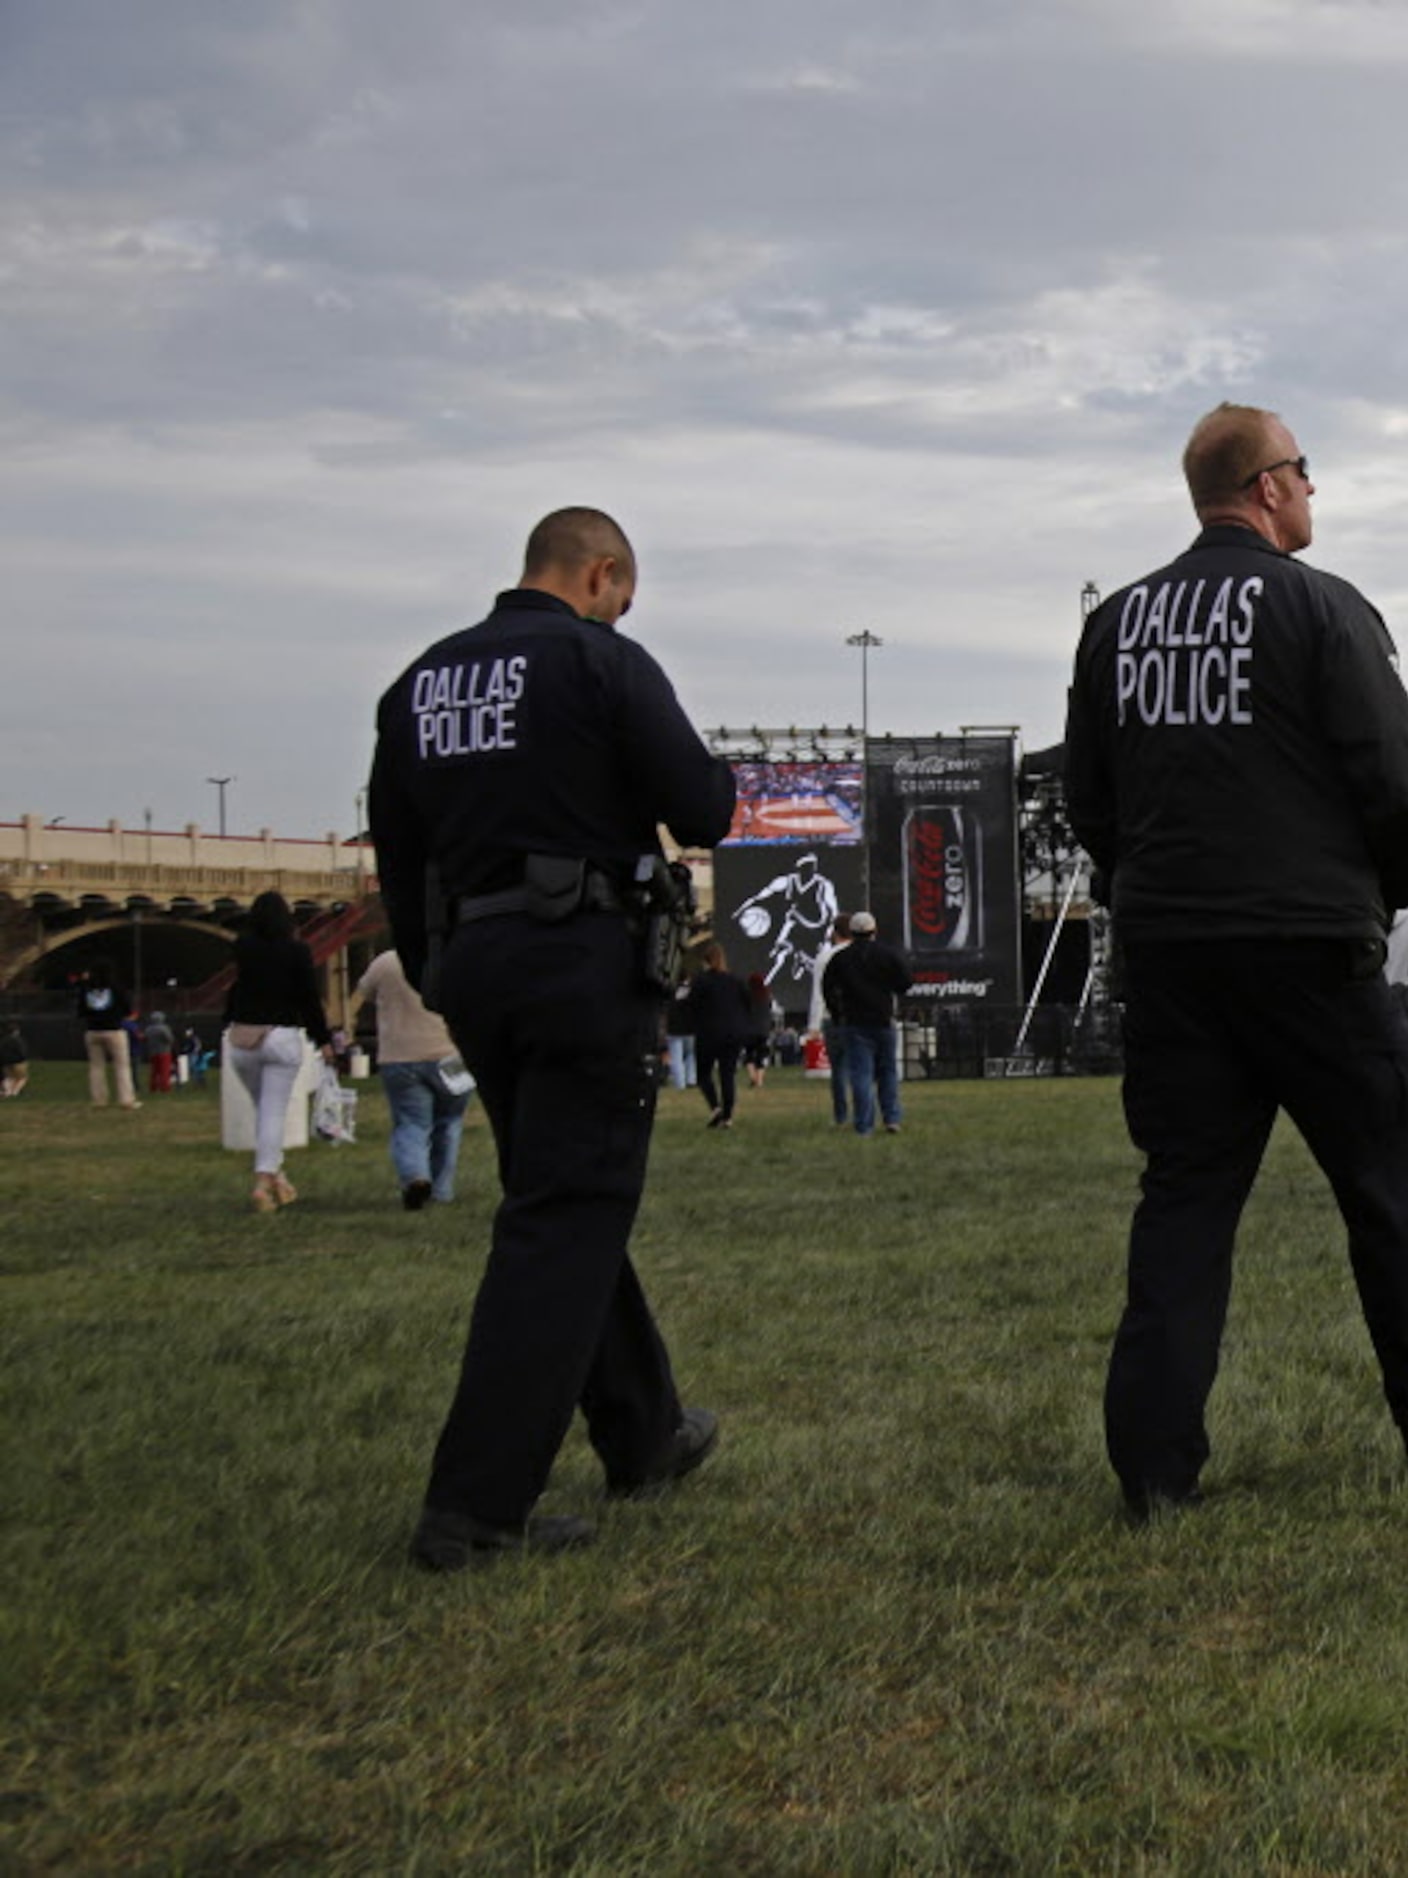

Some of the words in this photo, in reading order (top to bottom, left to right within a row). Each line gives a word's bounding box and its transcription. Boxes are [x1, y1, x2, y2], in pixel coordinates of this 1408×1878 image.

[1118, 576, 1263, 651] DALLAS
[412, 656, 527, 714] DALLAS
[1117, 647, 1253, 727] POLICE
[418, 702, 516, 759] POLICE
[945, 845, 963, 908] zero
